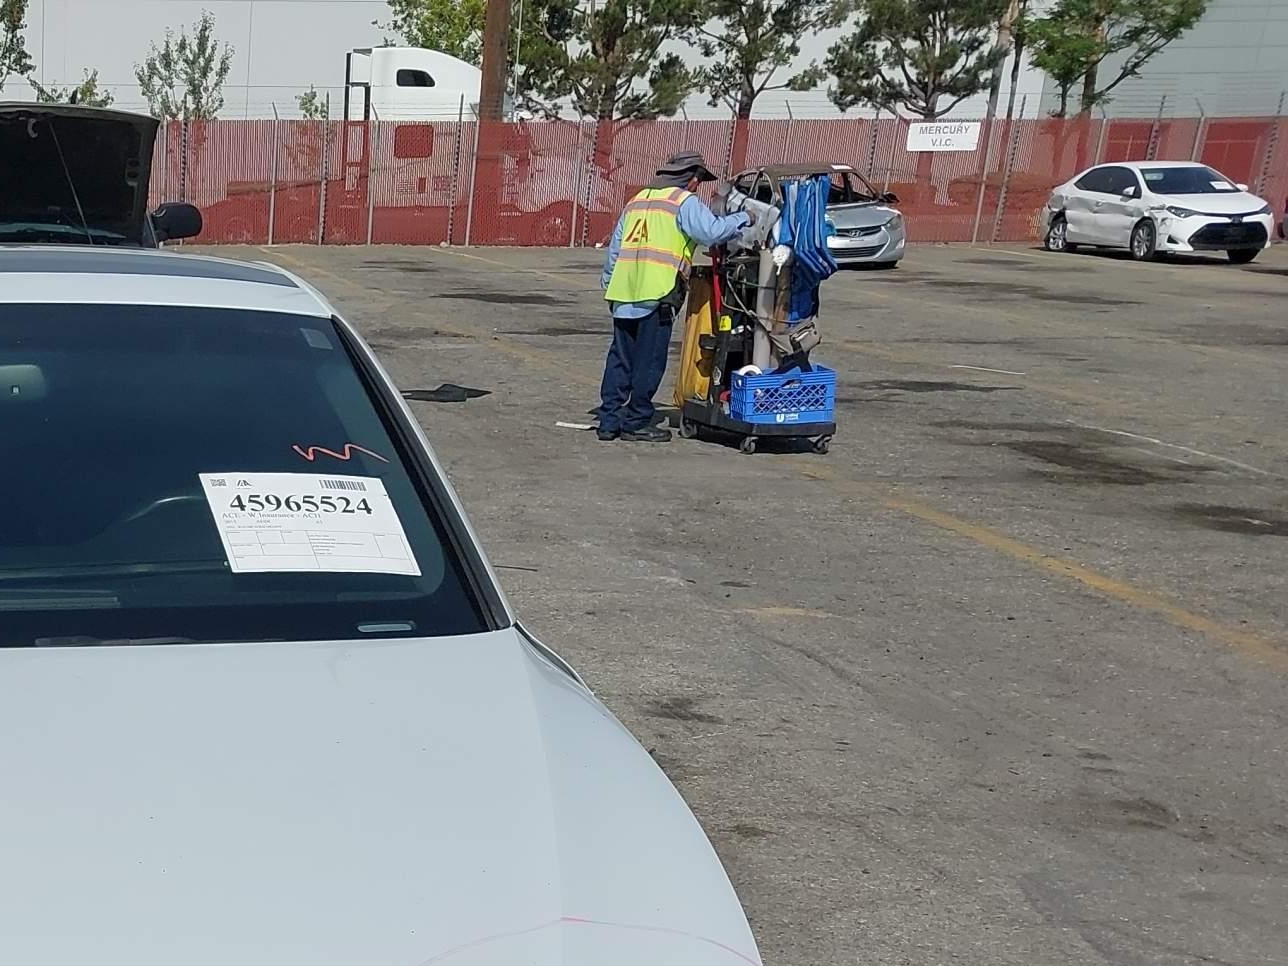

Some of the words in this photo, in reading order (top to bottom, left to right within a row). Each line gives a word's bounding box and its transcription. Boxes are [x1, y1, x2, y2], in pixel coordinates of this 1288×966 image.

[919, 125, 970, 134] MERCURY
[931, 138, 954, 147] V.I.C.
[230, 494, 372, 515] 45965524
